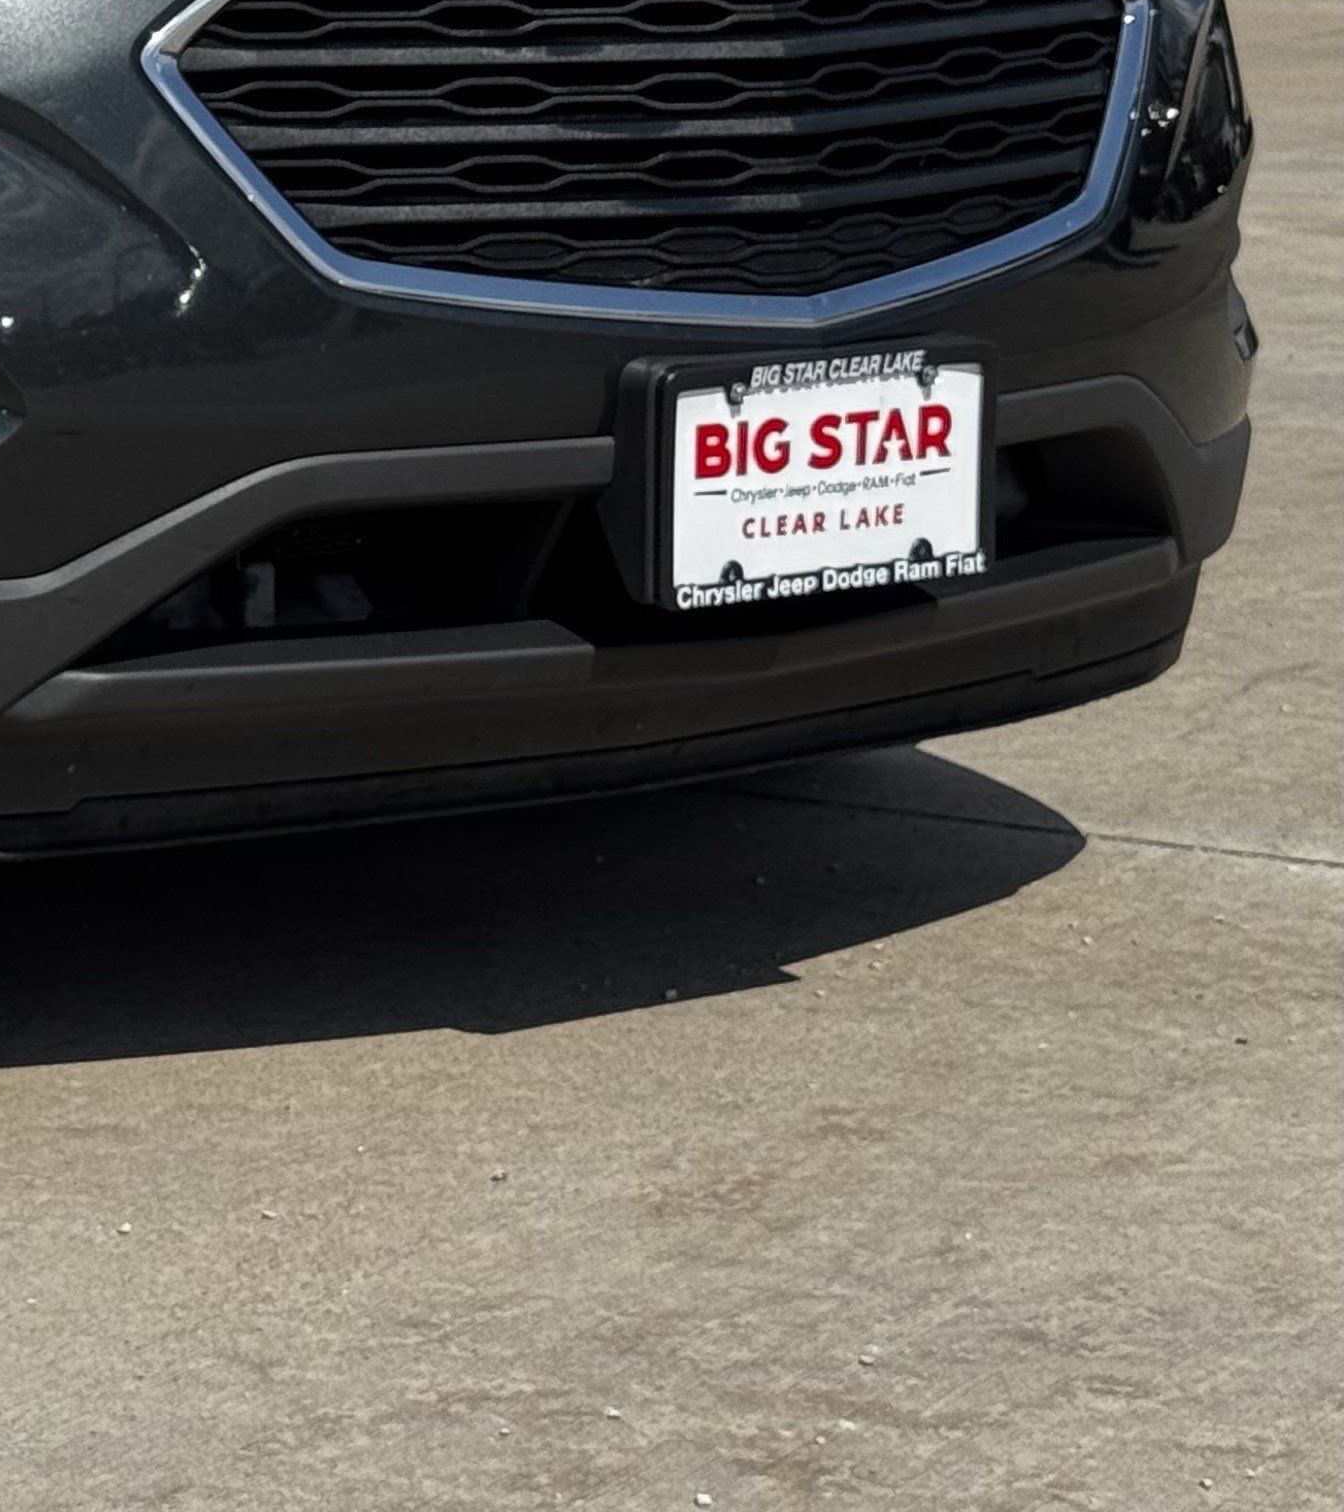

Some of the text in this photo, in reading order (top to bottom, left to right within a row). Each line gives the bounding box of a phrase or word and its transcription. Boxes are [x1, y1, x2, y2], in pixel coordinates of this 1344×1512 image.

[750, 349, 927, 388] BIG STAR CLEAR LAKE
[694, 403, 952, 480] BIG STAR
[730, 487, 779, 505] Chrysler
[892, 472, 917, 487] Fiat
[741, 503, 905, 540] CLEAR LAKE
[676, 549, 988, 610] Chrysler Jeep Dodge Ram Fiat
